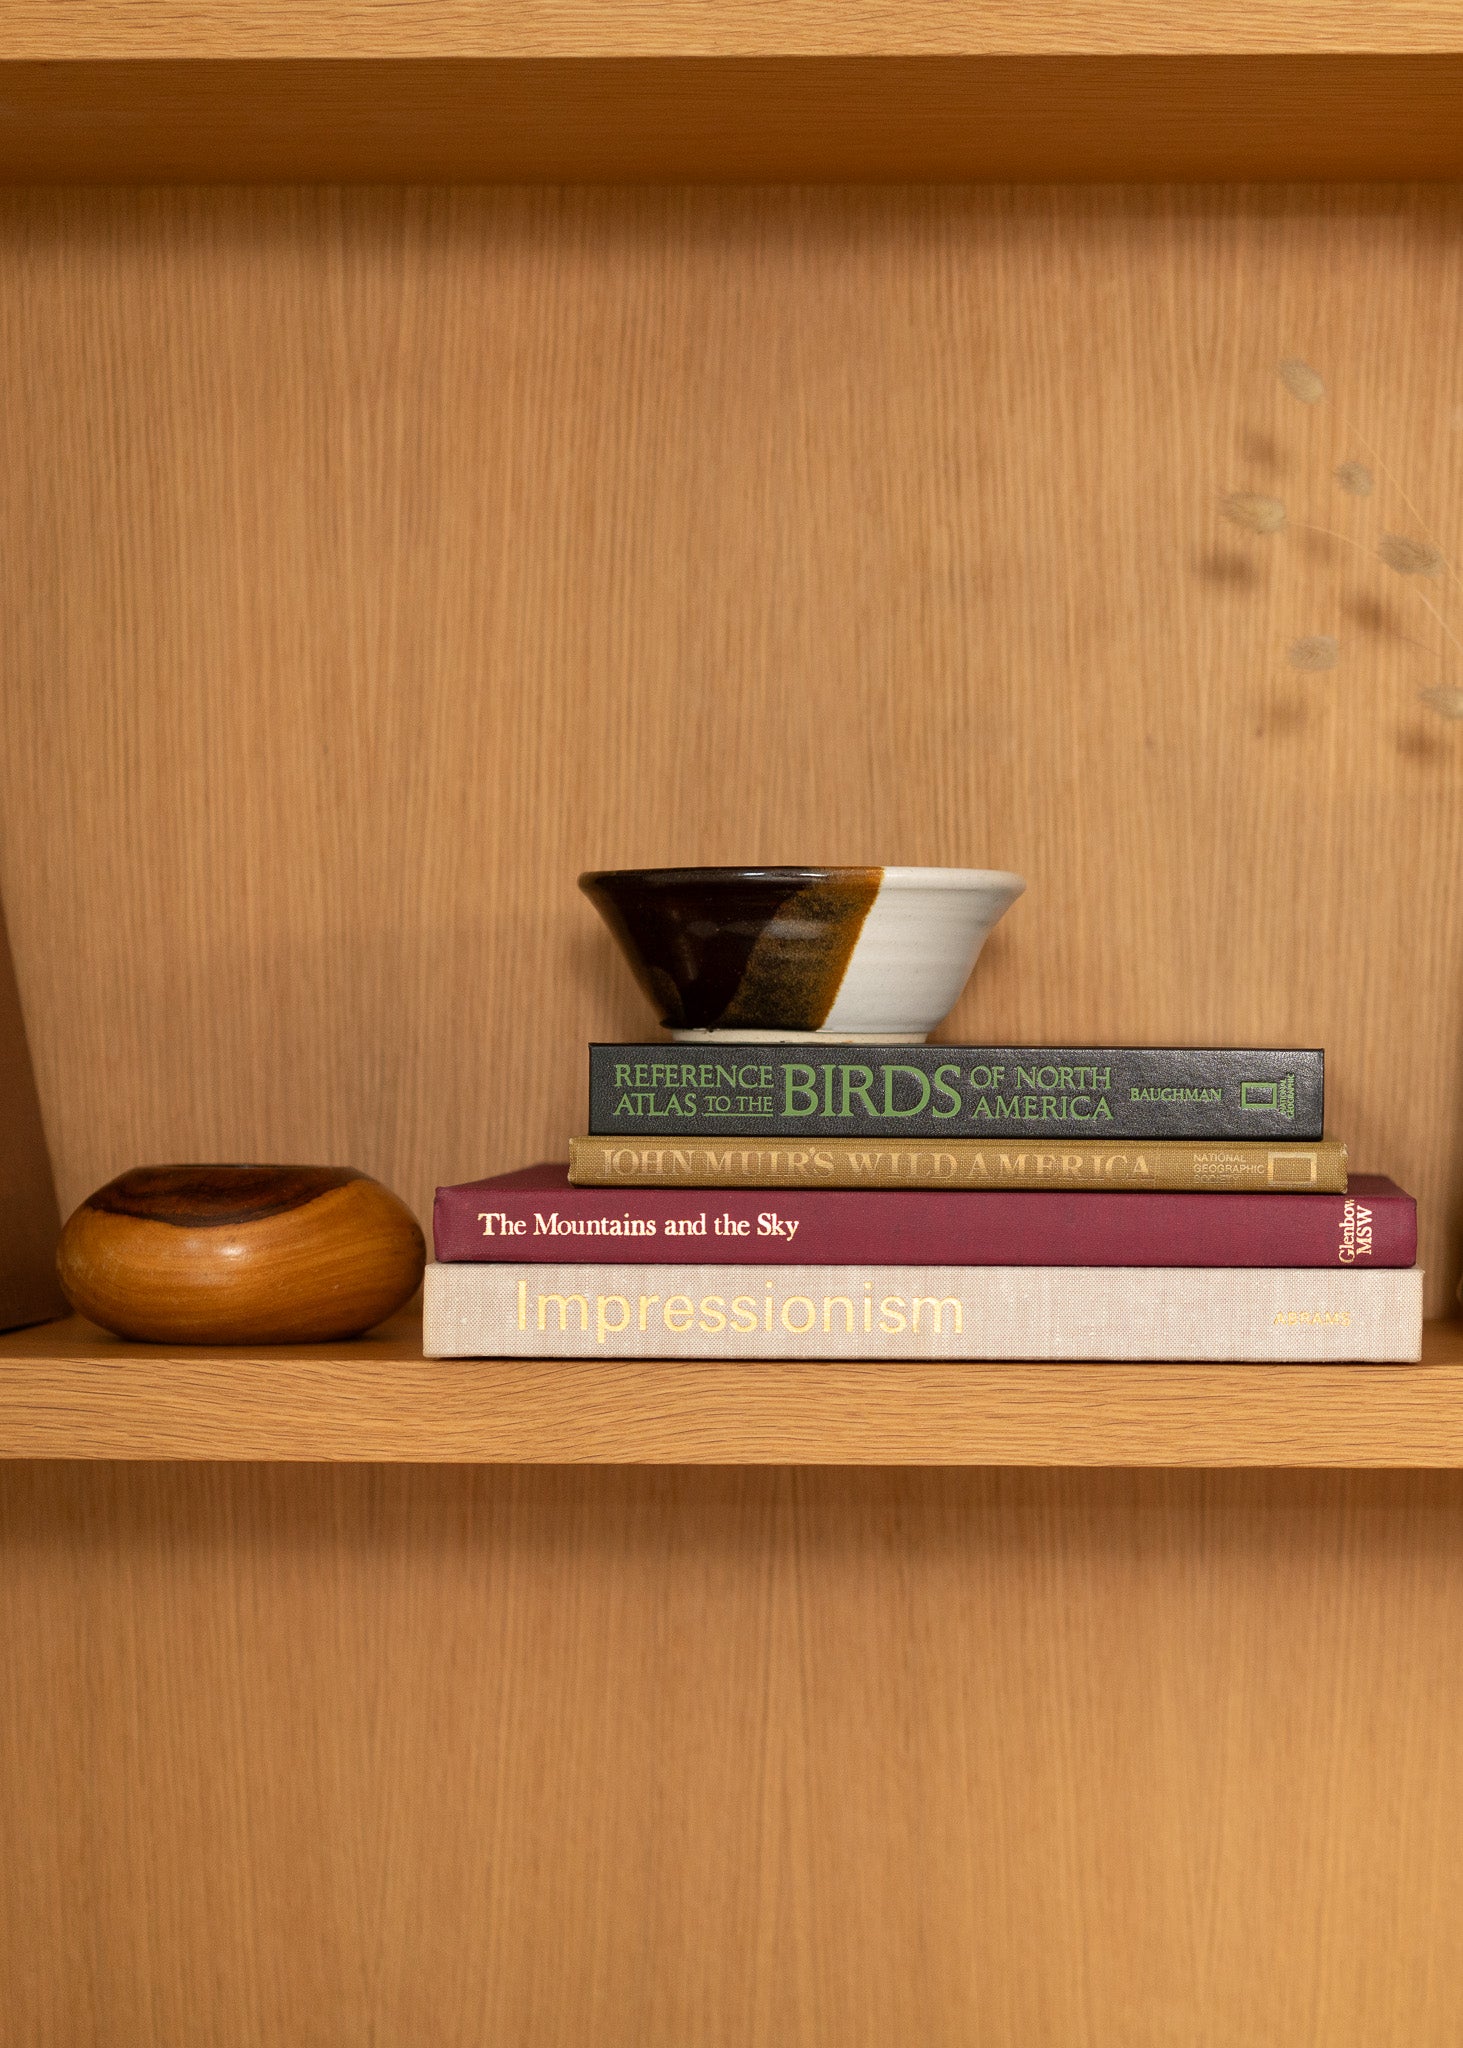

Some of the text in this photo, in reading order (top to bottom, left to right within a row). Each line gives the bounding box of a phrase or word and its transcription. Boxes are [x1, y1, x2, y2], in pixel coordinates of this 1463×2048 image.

[614, 1064, 774, 1088] REFERENCE
[969, 1065, 1112, 1090] OF NORTH
[780, 1064, 962, 1119] BIRDS
[1130, 1088, 1222, 1102] BAUGHMAN
[613, 1093, 774, 1117] ATLAS TO THE
[972, 1095, 1114, 1120] AMERICA
[597, 1149, 694, 1177] JOHN
[848, 1152, 957, 1180] WILD
[967, 1152, 1154, 1181] AMERICA
[1193, 1153, 1246, 1162] NATIONAL
[1193, 1164, 1265, 1174] GEOGRAPHIC
[478, 1213, 799, 1241] The Mountains and the Sky
[1356, 1205, 1372, 1255] MSW
[517, 1280, 963, 1344] Impressionism
[1274, 1311, 1351, 1327] ABRAMS
